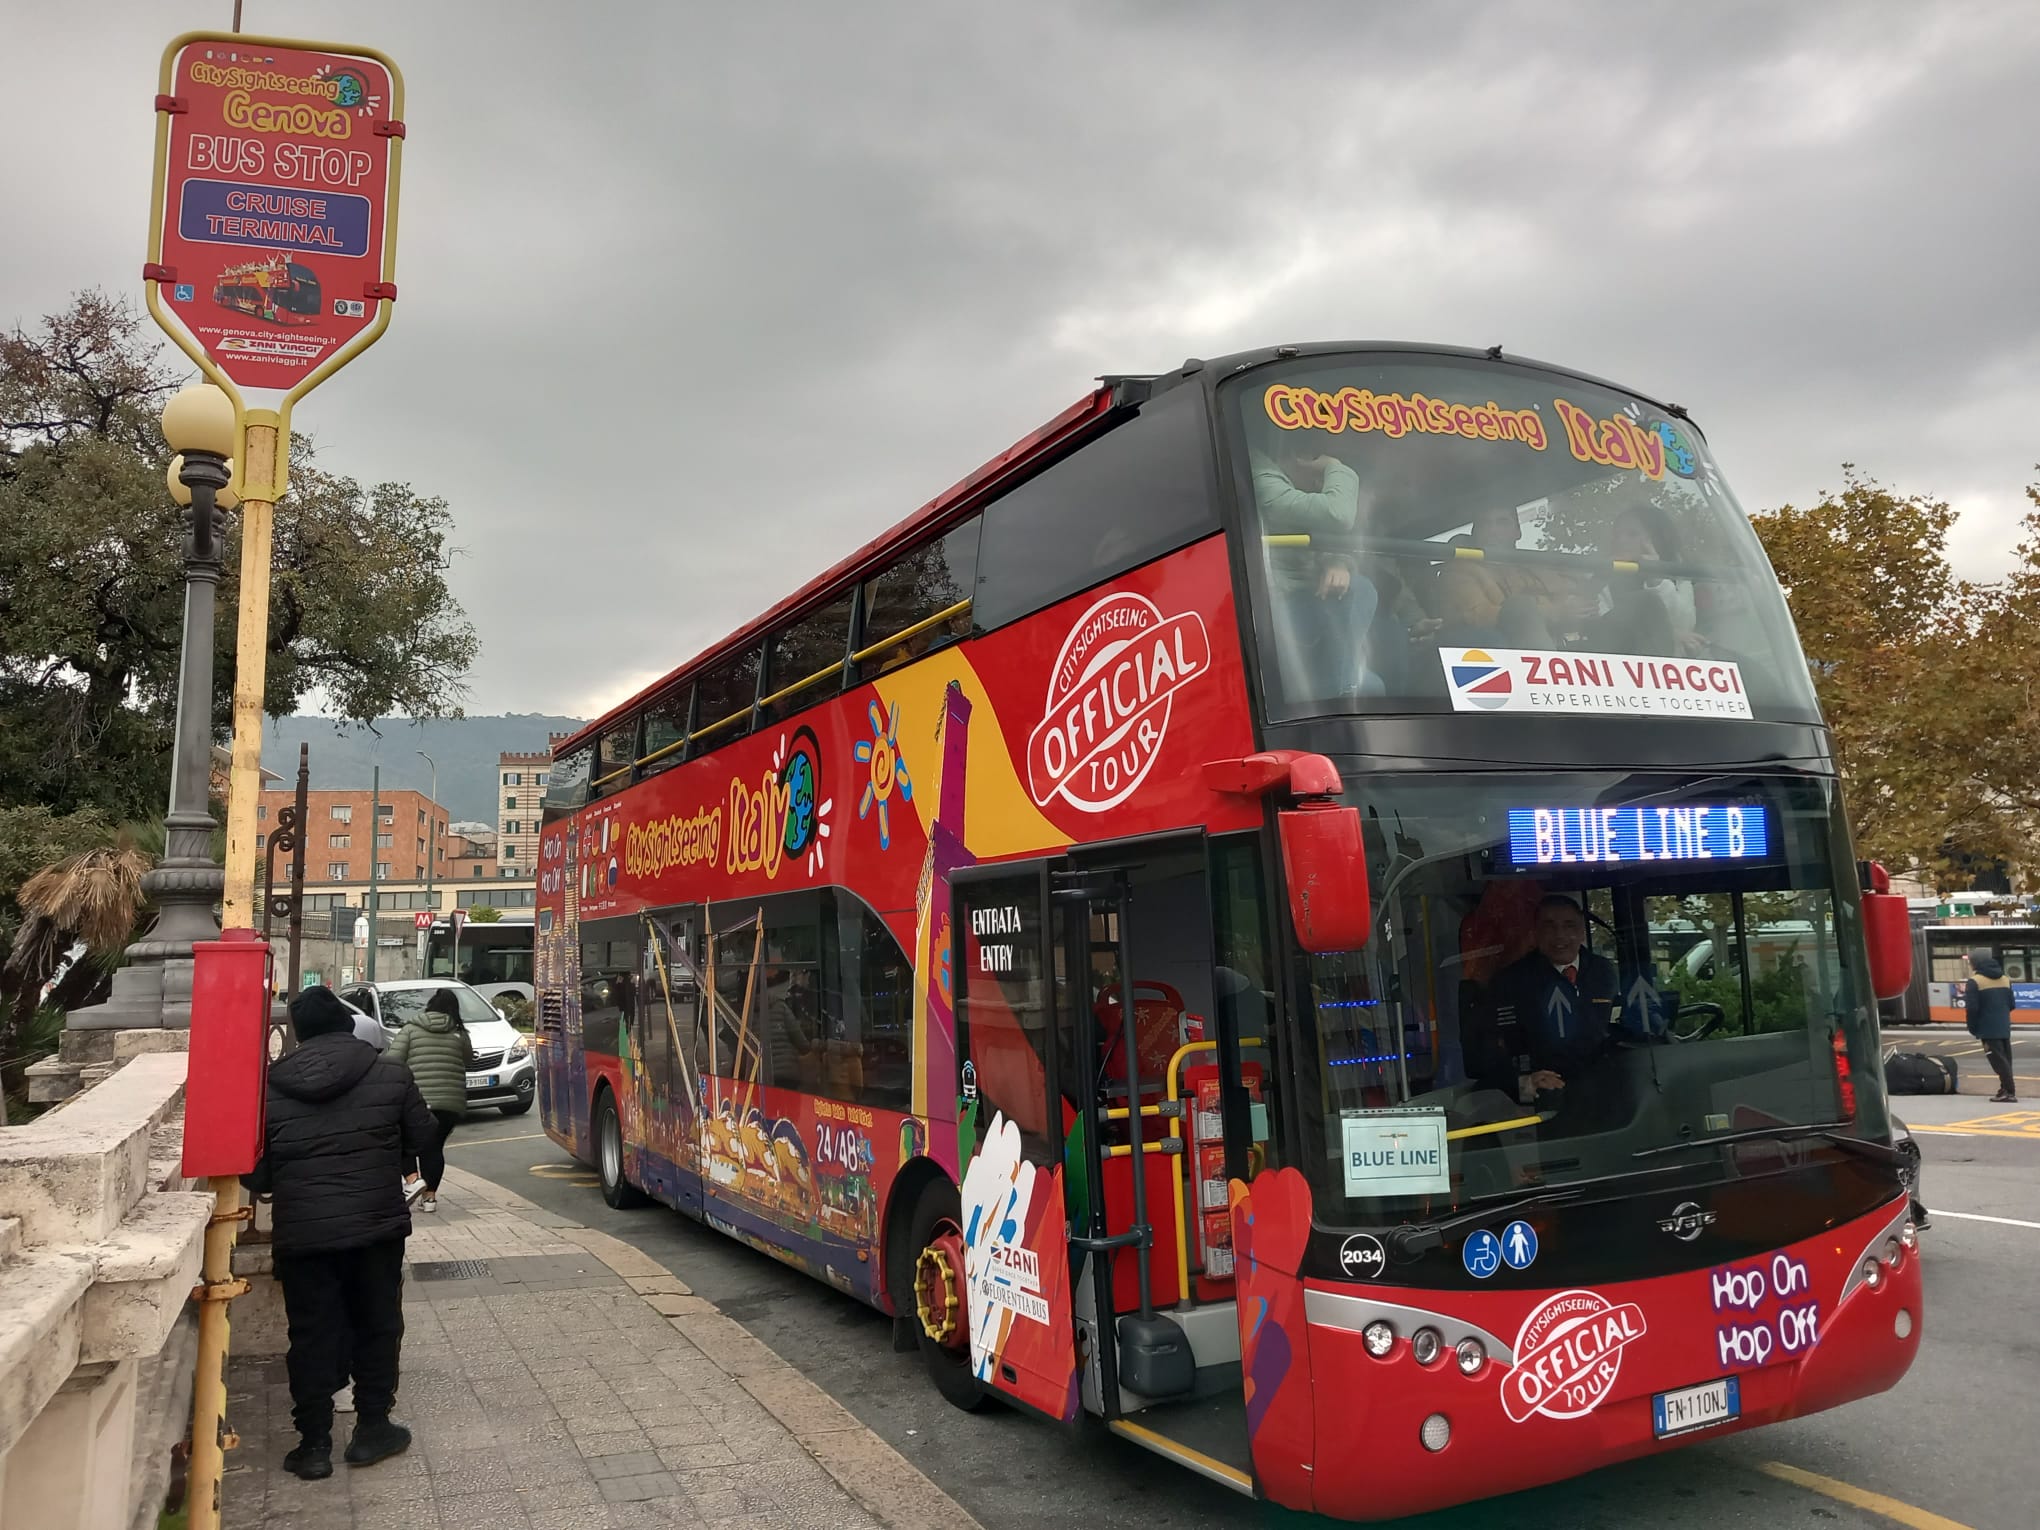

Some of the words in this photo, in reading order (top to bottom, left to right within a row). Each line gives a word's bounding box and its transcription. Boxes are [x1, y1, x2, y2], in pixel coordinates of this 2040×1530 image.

[190, 61, 340, 100] CitySightseeing
[224, 90, 351, 139] Genova
[188, 133, 264, 175] BUS
[274, 143, 372, 187] STOP
[226, 191, 327, 220] CRUISE
[206, 214, 343, 247] TERMINAL
[198, 326, 337, 345] www.genova.city-sightseeing.it
[249, 341, 276, 350] ZANI
[278, 342, 317, 353] VIAGGI
[225, 352, 307, 367] www.zaniviaggi.it
[1264, 383, 1548, 451] CitySightseeing
[1554, 398, 1665, 481] Italy
[1058, 607, 1148, 693] CITYSIGHTSEEING
[1520, 656, 1615, 688] ZANI
[1622, 661, 1742, 694] VIAGGI
[1043, 626, 1197, 779] OFFICIAL
[1529, 692, 1651, 710] EXPERIENCE
[1660, 696, 1747, 714] TOGETHER
[1089, 718, 1159, 793] TOUR
[626, 805, 722, 880] CitySightseeing
[726, 769, 790, 880] Italy
[1533, 808, 1621, 863] BLUE
[1637, 807, 1712, 860] LINE
[1727, 807, 1746, 858] B
[416, 914, 431, 925] M
[972, 905, 1021, 935] ENTRATA
[980, 944, 1013, 972] ENTRY
[1351, 1151, 1395, 1168] BLUE
[1400, 1150, 1438, 1166] LINE
[1003, 1246, 1038, 1277] ZANI
[1343, 1250, 1383, 1265] 2034
[1712, 1270, 1765, 1309] Hop
[1772, 1255, 1808, 1293] On
[988, 1283, 1031, 1314] FLORENTIA
[1032, 1299, 1047, 1320] BUS
[1524, 1298, 1600, 1351] CITYSIGHTSEEING
[1718, 1324, 1772, 1364] Hop
[1779, 1304, 1818, 1351] Off
[1517, 1310, 1638, 1404] OFFICIAL
[1562, 1360, 1615, 1408] TOUR
